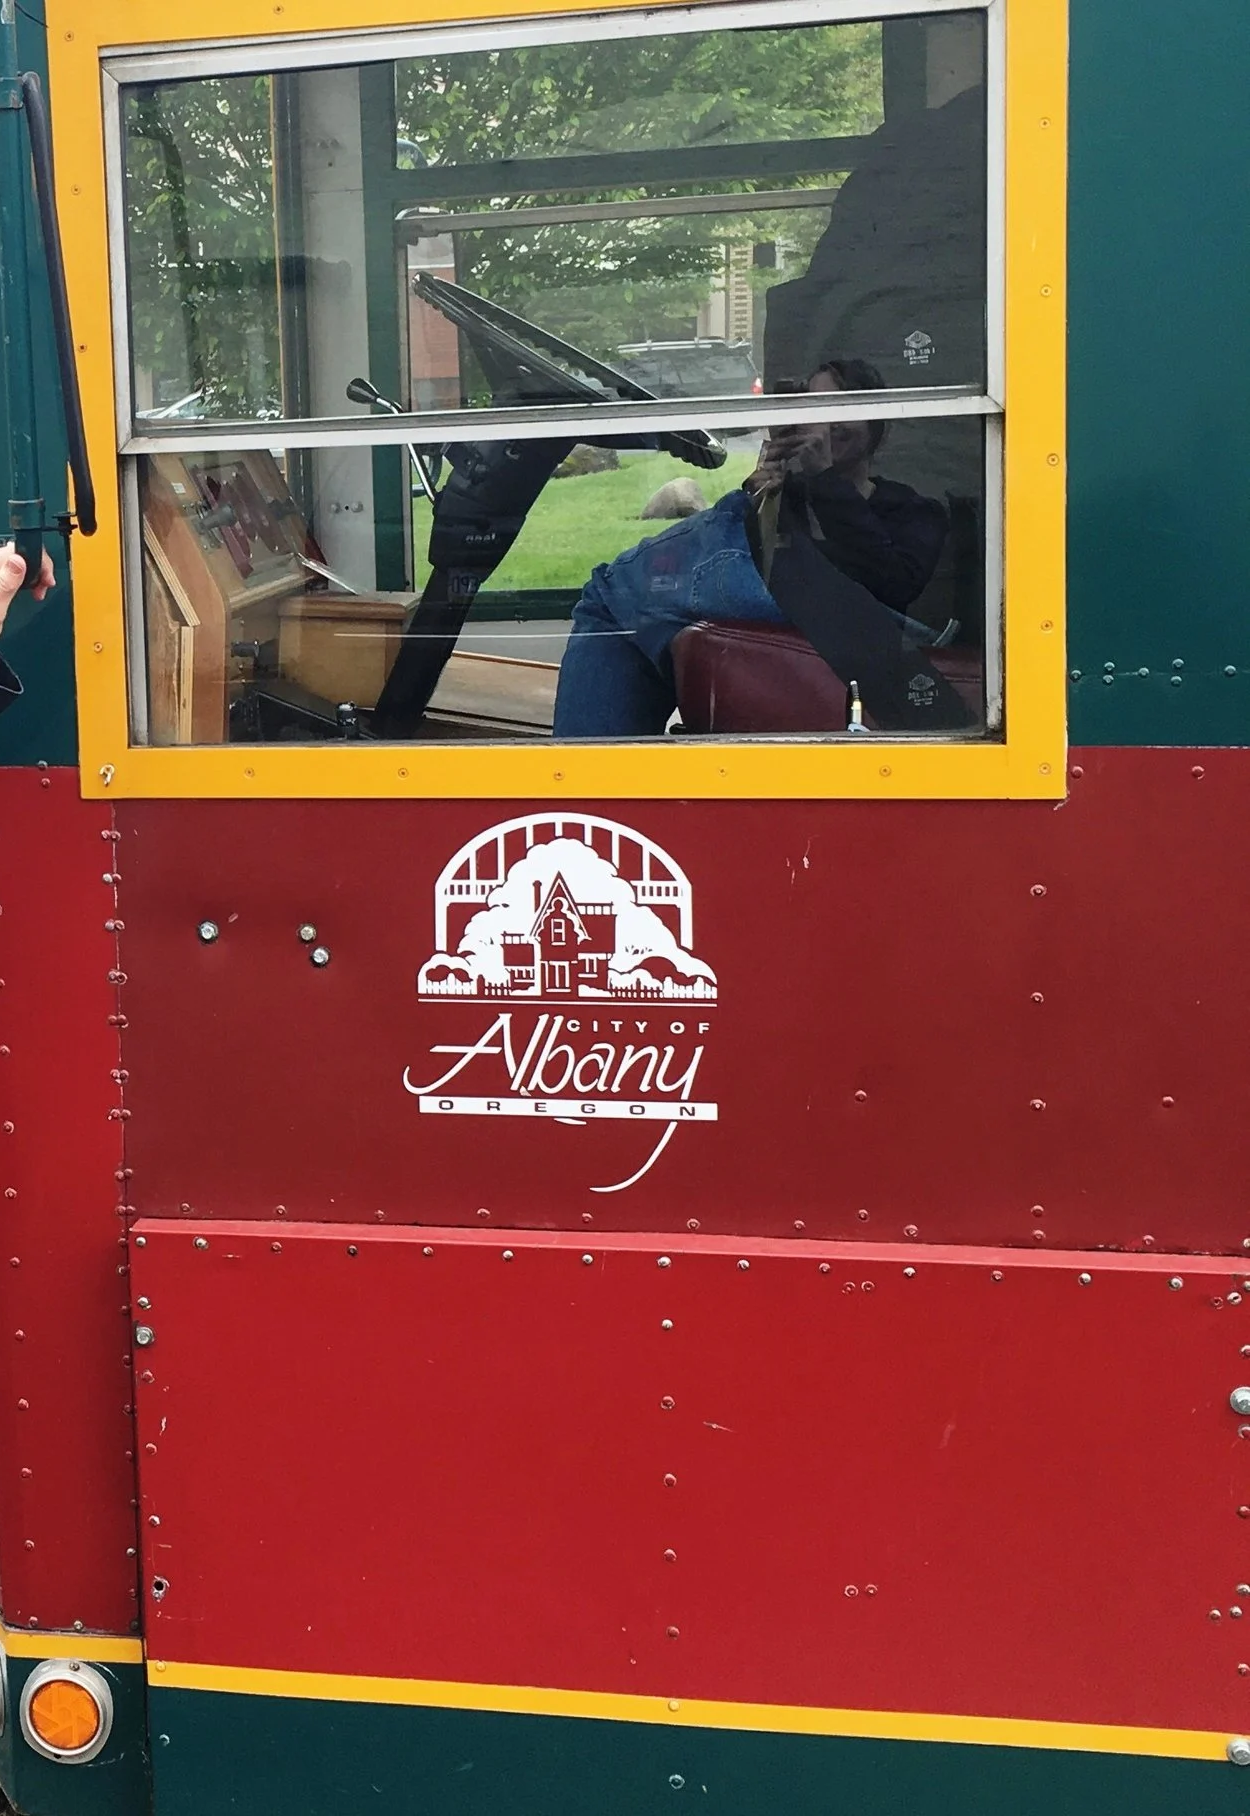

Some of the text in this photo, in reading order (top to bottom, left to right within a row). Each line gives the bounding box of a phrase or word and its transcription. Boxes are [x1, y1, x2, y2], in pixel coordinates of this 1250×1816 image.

[566, 1019, 710, 1034] CITY OF
[438, 1099, 696, 1117] OREGON
